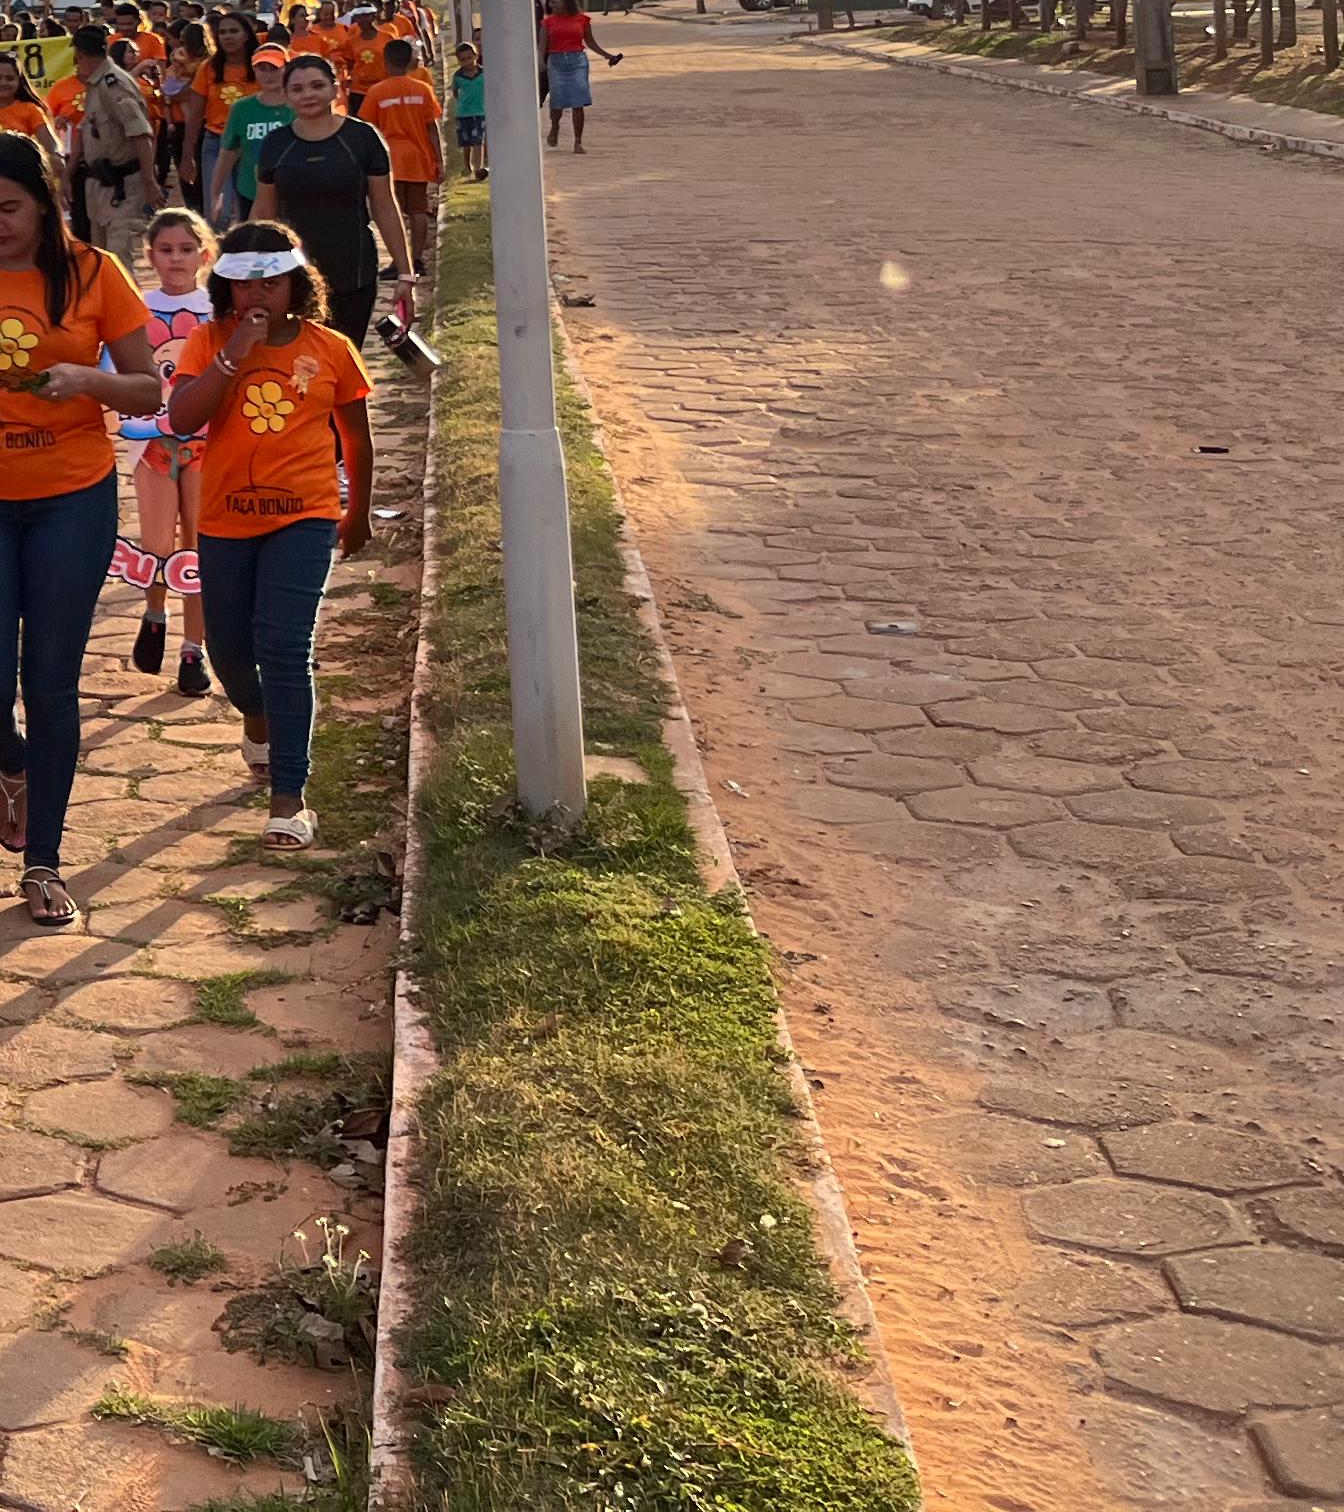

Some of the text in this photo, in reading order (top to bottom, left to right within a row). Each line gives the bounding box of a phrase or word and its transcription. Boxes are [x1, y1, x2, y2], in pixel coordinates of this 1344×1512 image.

[5, 430, 56, 449] BONITO
[225, 494, 304, 515] FAÇA BONITO
